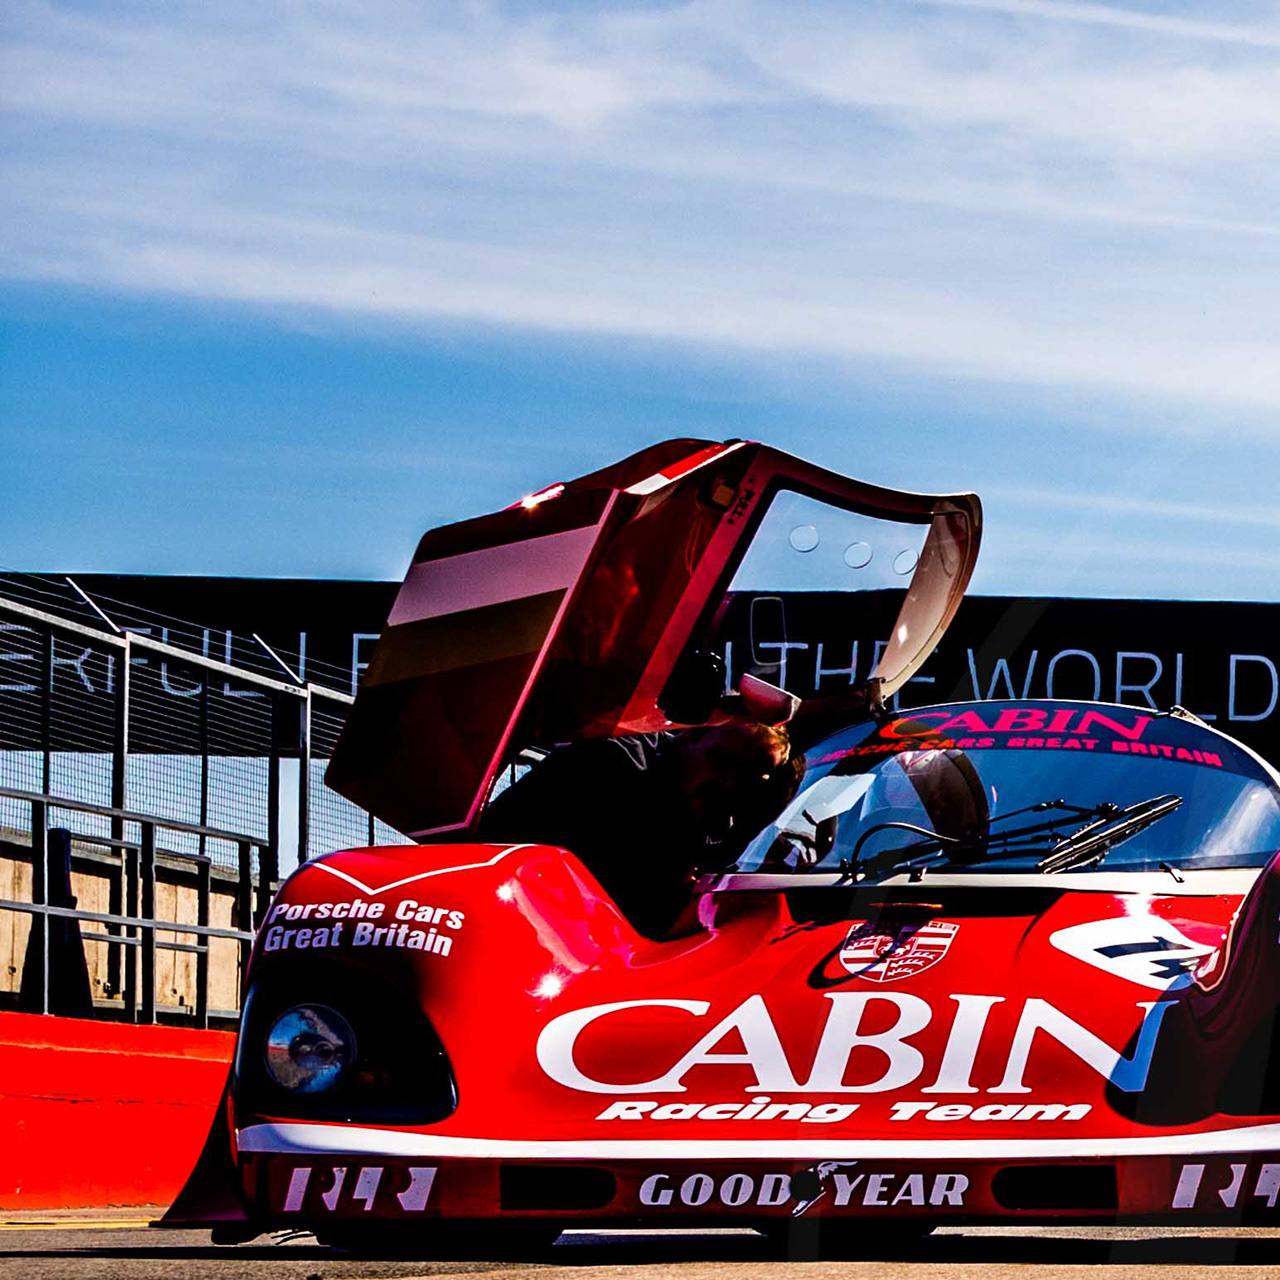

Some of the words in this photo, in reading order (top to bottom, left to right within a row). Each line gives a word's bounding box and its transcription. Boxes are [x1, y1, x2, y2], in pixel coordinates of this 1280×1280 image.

[879, 708, 1155, 741] CABIN
[919, 737, 996, 750] CARS
[1006, 737, 1099, 750] GREAT
[1111, 739, 1223, 767] BRITAIN
[268, 899, 386, 925] Porsche
[394, 899, 465, 930] Cars
[264, 922, 344, 952] Great
[352, 921, 453, 957] Britain
[536, 991, 1181, 1094] CABIN
[596, 1096, 861, 1124] Racing
[890, 1101, 1093, 1122] Team
